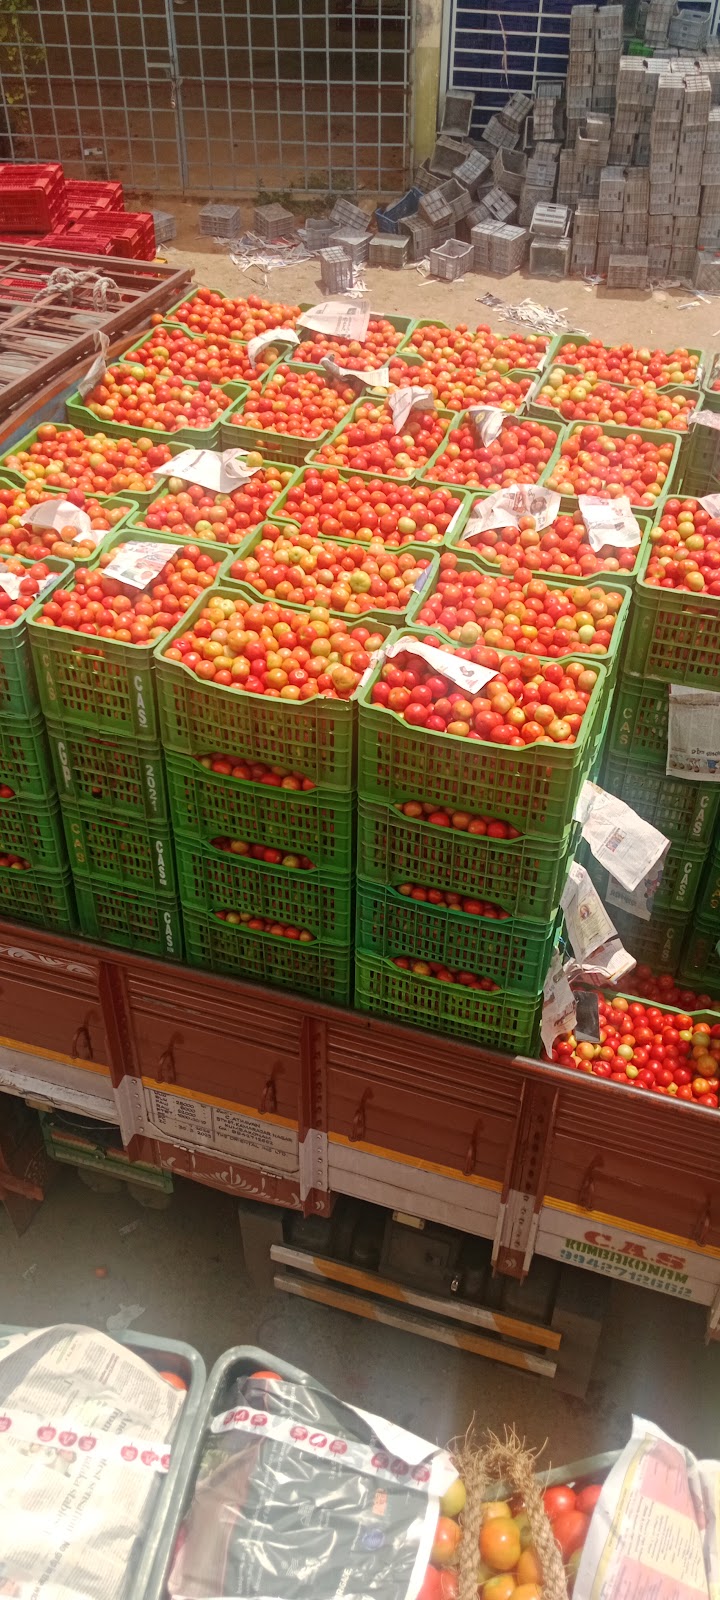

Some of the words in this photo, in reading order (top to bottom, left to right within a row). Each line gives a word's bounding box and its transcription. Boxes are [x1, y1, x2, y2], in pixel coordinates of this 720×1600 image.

[43, 654, 56, 700] CAS
[133, 675, 148, 726] CAS
[619, 707, 633, 745] CAS
[692, 795, 710, 834] CAS
[70, 823, 85, 863] CAS
[155, 840, 166, 878] CAS
[678, 861, 693, 896] CAS
[163, 911, 174, 947] CAS
[662, 927, 675, 959] CAS
[564, 1238, 690, 1284] KUMBAKONAM
[584, 1230, 687, 1271] C.A.S
[560, 1249, 693, 1298] 9942712662
